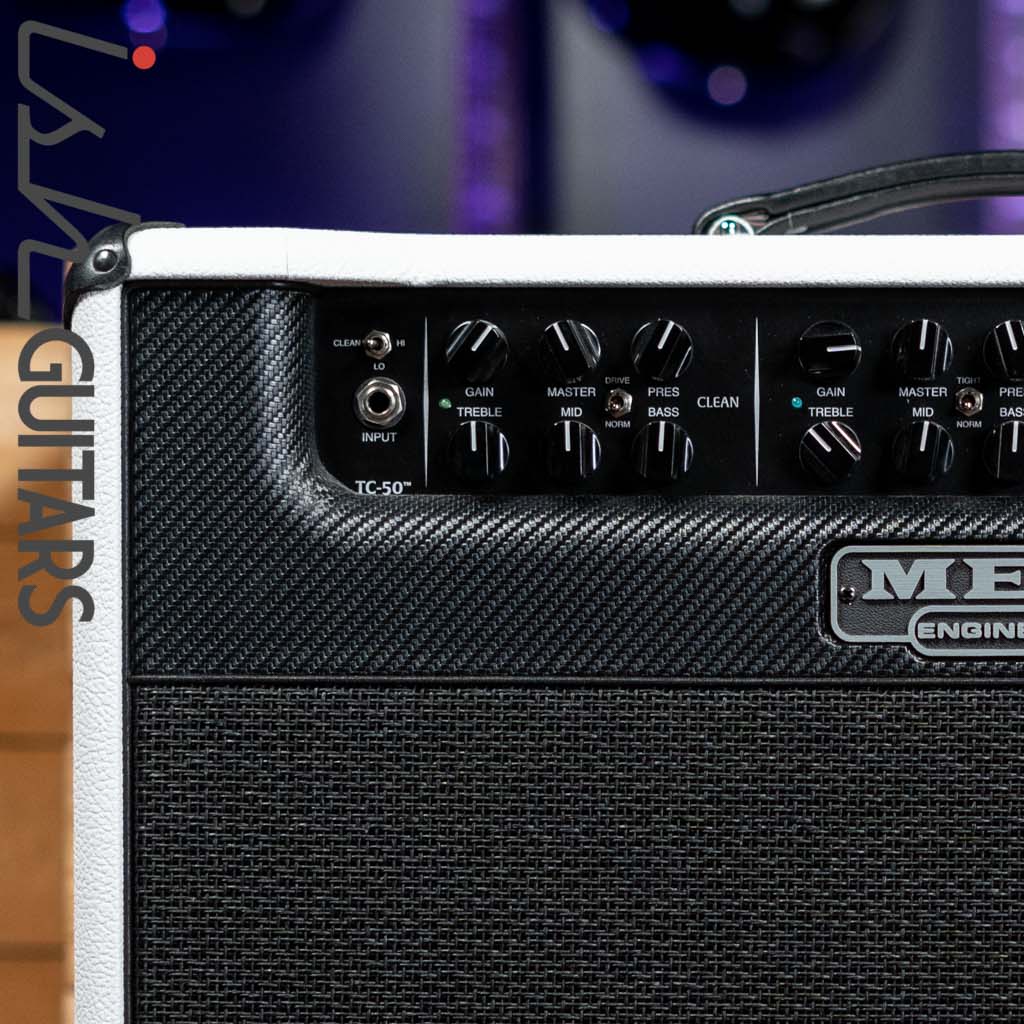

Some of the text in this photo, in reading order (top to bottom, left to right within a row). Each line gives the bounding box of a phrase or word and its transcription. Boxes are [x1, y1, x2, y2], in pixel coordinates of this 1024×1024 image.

[333, 338, 361, 348] CLEAN
[396, 339, 406, 347] HI
[373, 363, 386, 371] LO
[604, 376, 631, 385] DRIVE
[465, 386, 495, 398] GAIN
[547, 386, 597, 397] MASTER
[648, 386, 680, 398] PRES
[816, 386, 846, 398] GAIN
[898, 386, 948, 397] MASTER
[696, 396, 740, 409] CLEAN
[456, 406, 503, 418] TREBLE
[560, 406, 583, 417] MID
[648, 406, 680, 418] BASS
[807, 406, 854, 418] TREBLE
[912, 406, 935, 418] MID
[604, 420, 631, 429] NORM
[956, 420, 983, 429] NORM
[361, 431, 398, 443] INPUT
